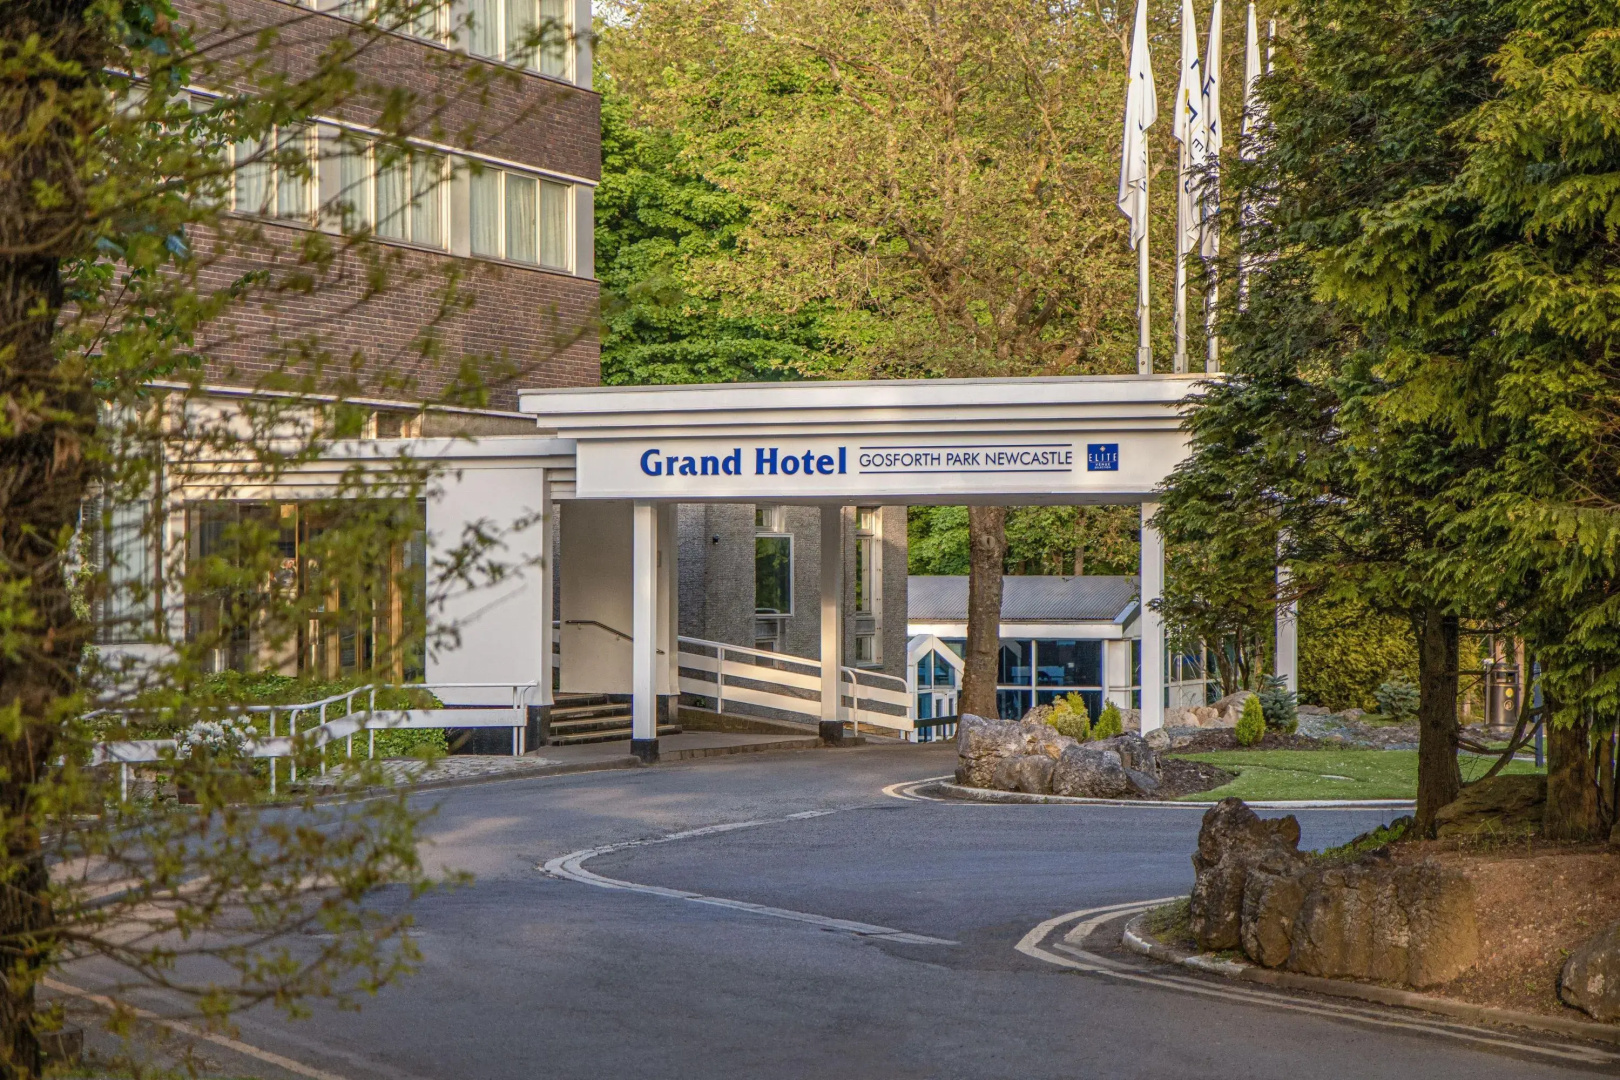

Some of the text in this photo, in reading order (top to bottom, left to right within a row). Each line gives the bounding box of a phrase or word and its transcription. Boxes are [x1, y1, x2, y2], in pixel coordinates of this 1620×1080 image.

[640, 446, 847, 476] Grand Hotel
[859, 451, 1073, 467] GOSFORTH PARK NEWCASTLE
[1089, 453, 1117, 462] ELITE
